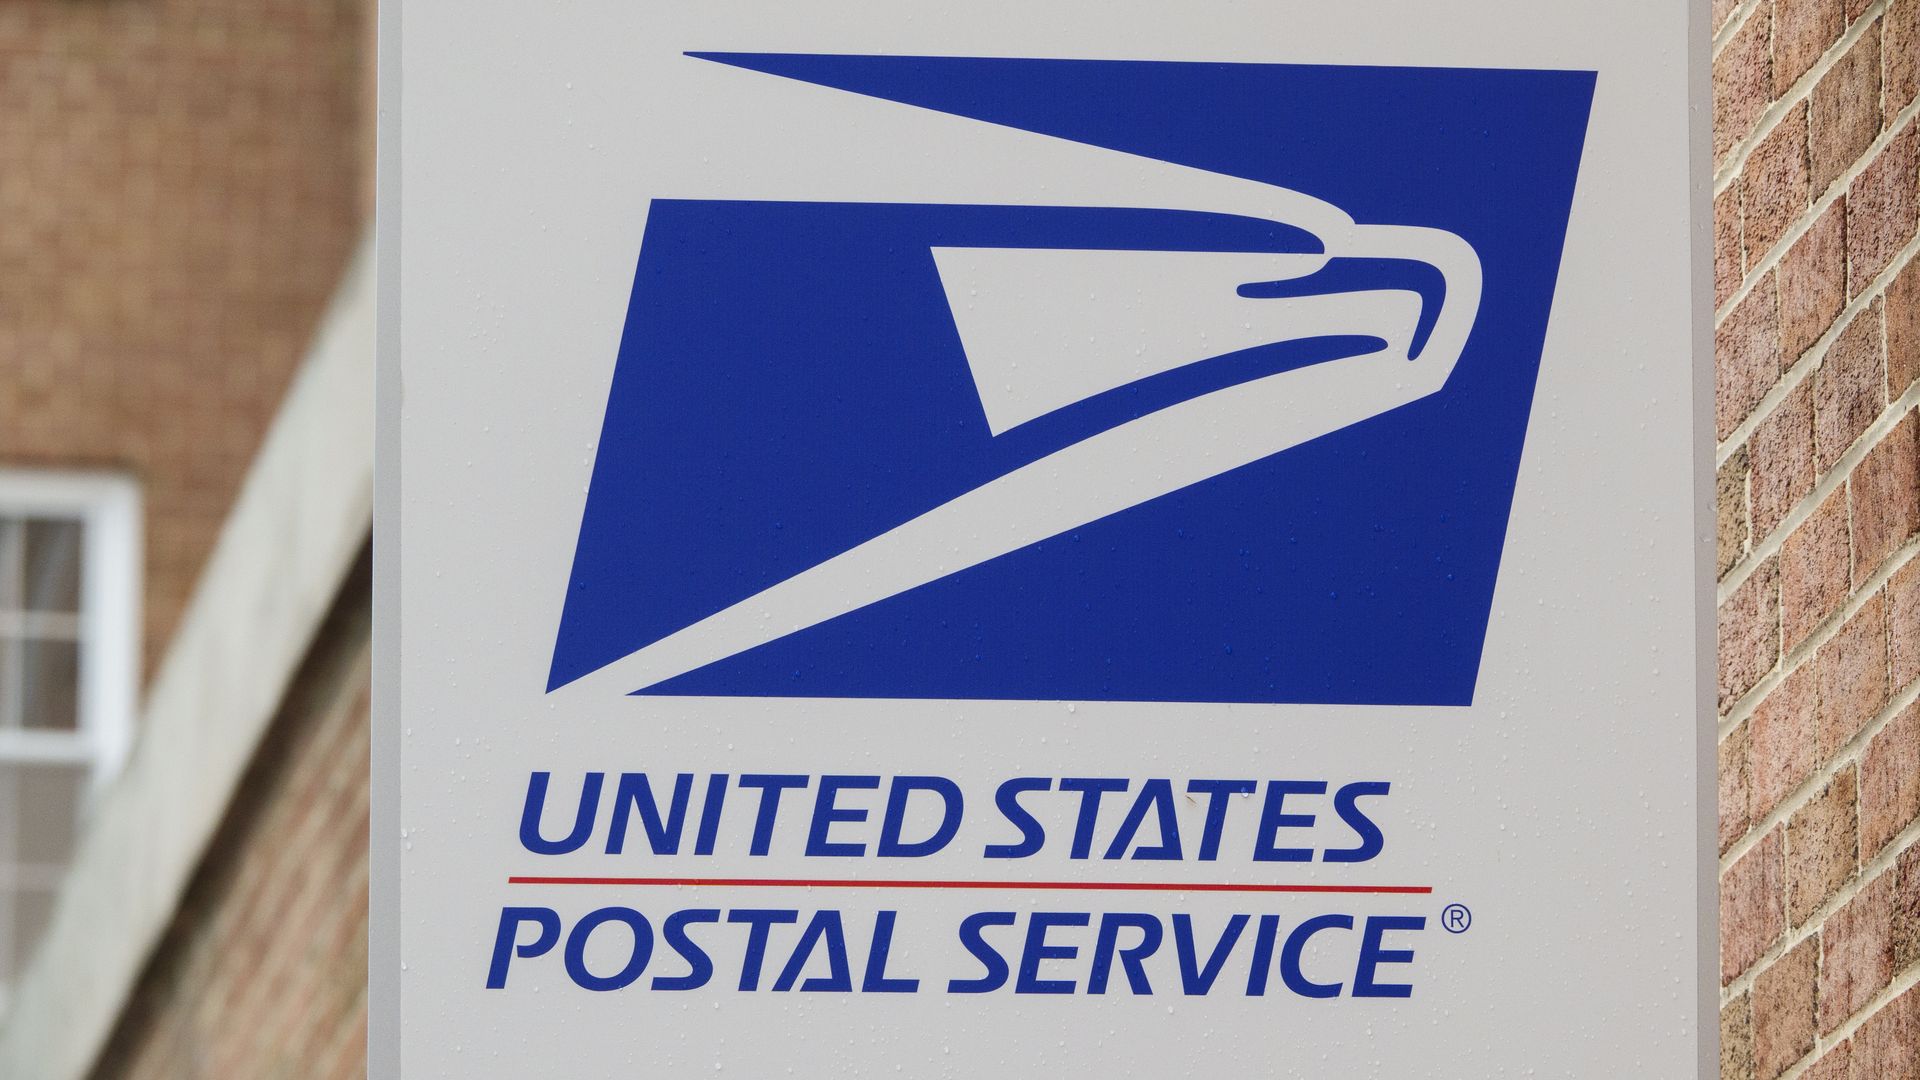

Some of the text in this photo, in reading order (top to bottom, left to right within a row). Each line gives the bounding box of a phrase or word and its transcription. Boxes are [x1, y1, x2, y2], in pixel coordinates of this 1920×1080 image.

[518, 771, 1393, 863] UNITED STATES
[486, 906, 920, 993] POSTAL
